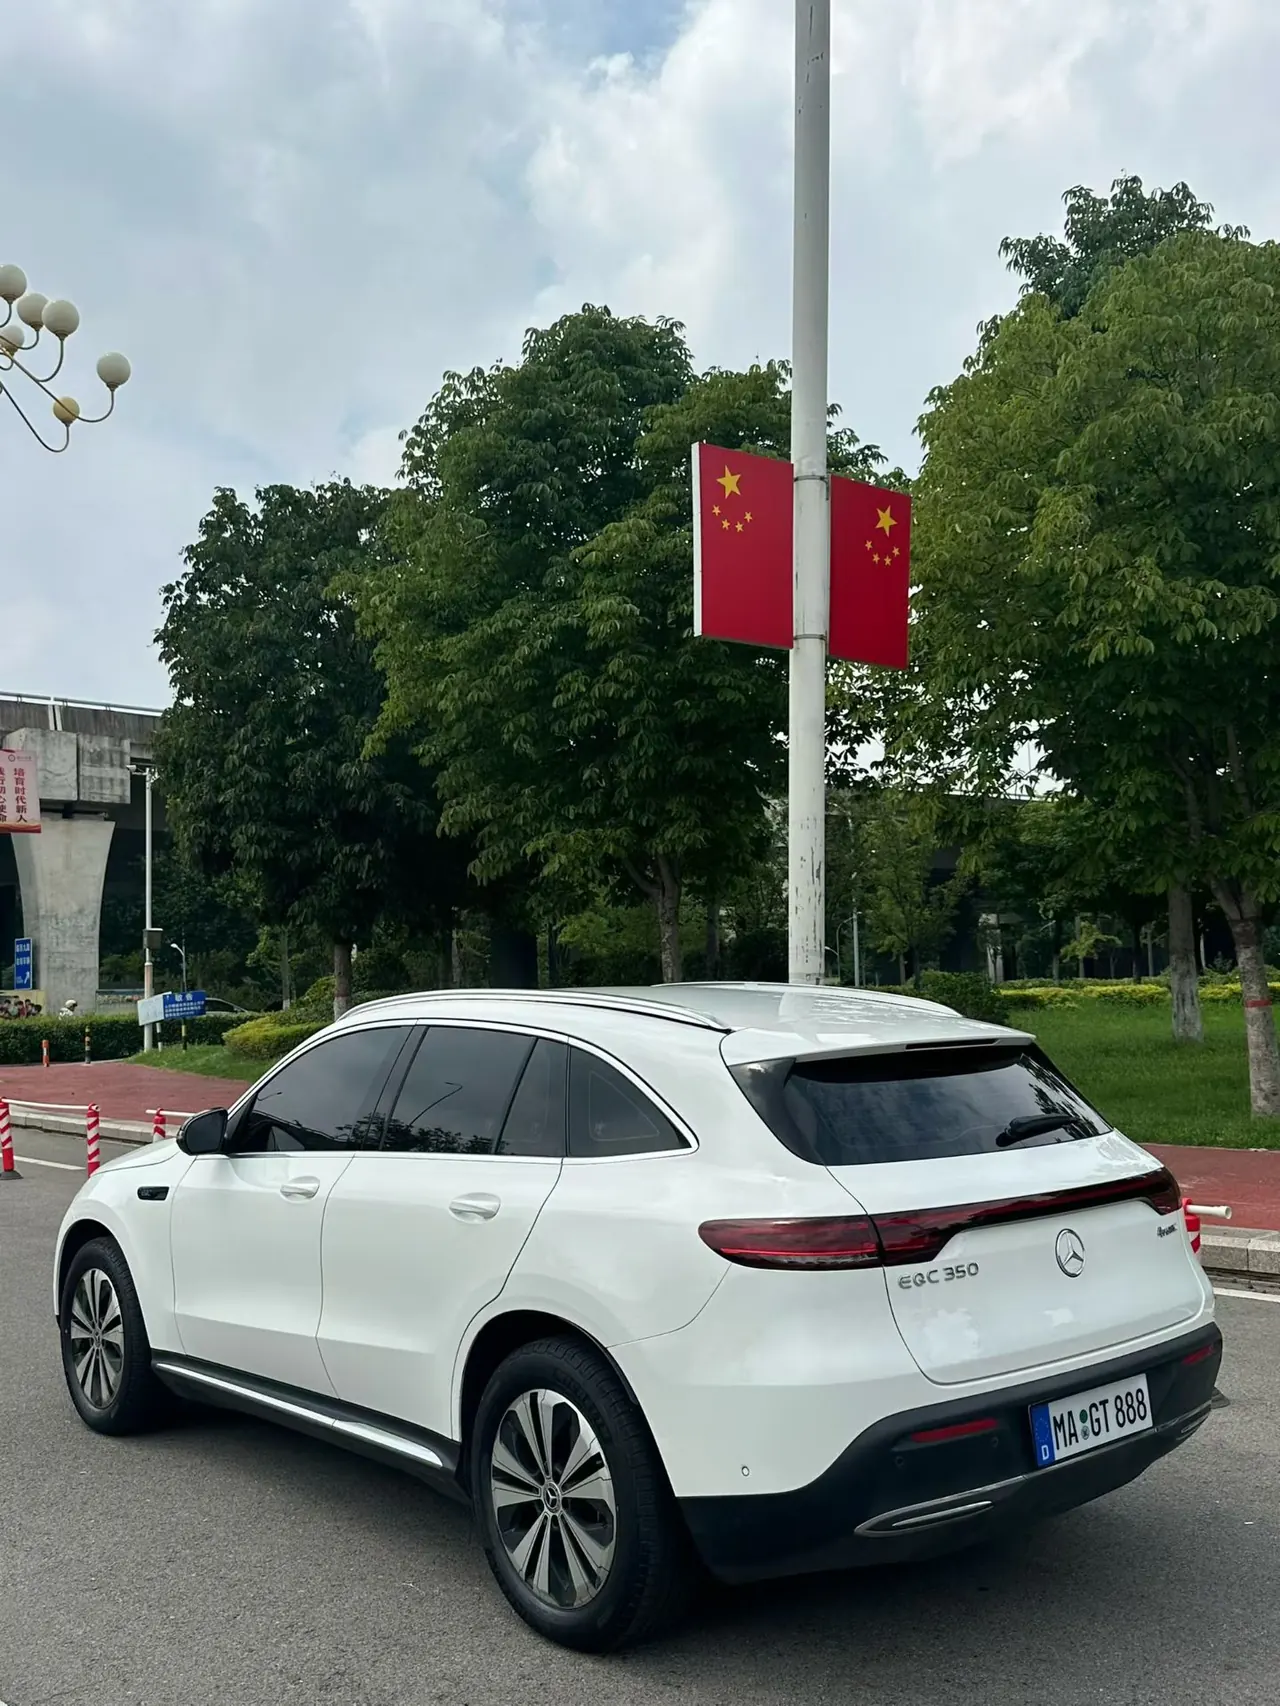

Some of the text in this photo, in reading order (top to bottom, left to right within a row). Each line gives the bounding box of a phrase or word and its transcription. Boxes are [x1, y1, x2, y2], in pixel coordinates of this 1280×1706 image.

[14, 767, 27, 823] 培育时代新人
[898, 1262, 979, 1290] EQC 350
[1052, 1388, 1148, 1451] MA GT 888
[1041, 1444, 1050, 1460] D
